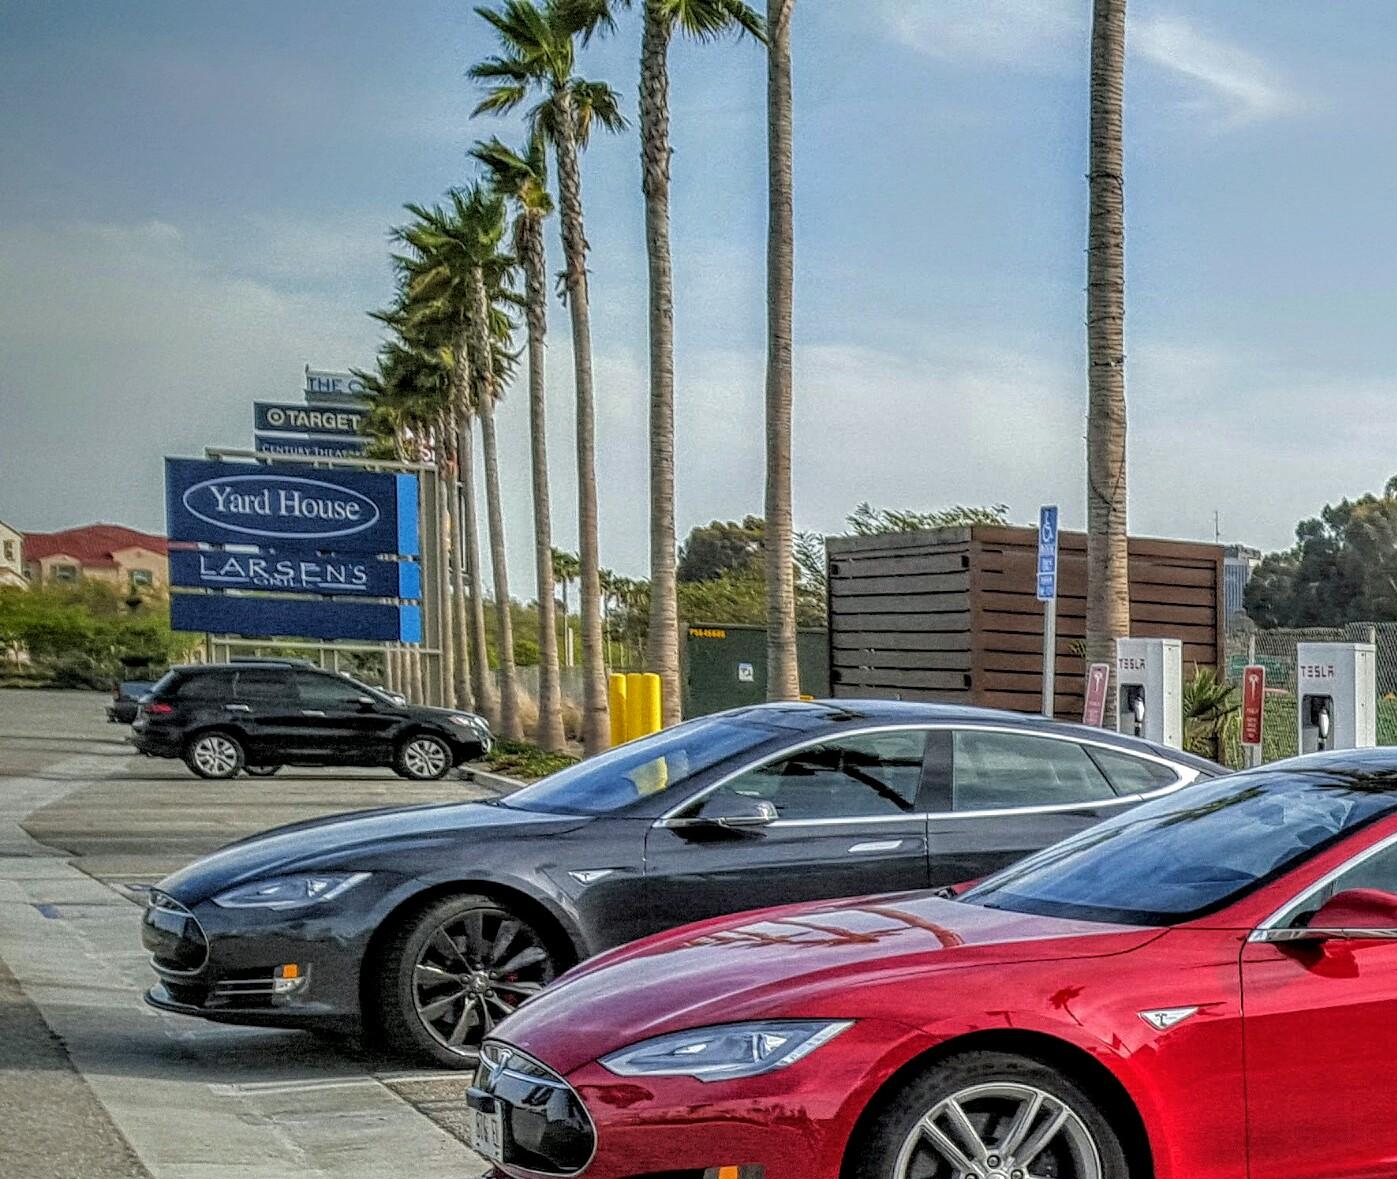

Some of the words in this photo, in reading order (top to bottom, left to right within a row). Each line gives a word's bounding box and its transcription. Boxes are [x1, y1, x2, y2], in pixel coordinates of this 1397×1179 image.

[308, 376, 343, 393] THE
[286, 410, 362, 430] TARGET
[208, 485, 270, 515] Yard
[278, 490, 361, 520] House
[199, 555, 368, 585] LARSEN'S
[1118, 658, 1146, 670] TESLA
[1300, 665, 1335, 678] TESLA
